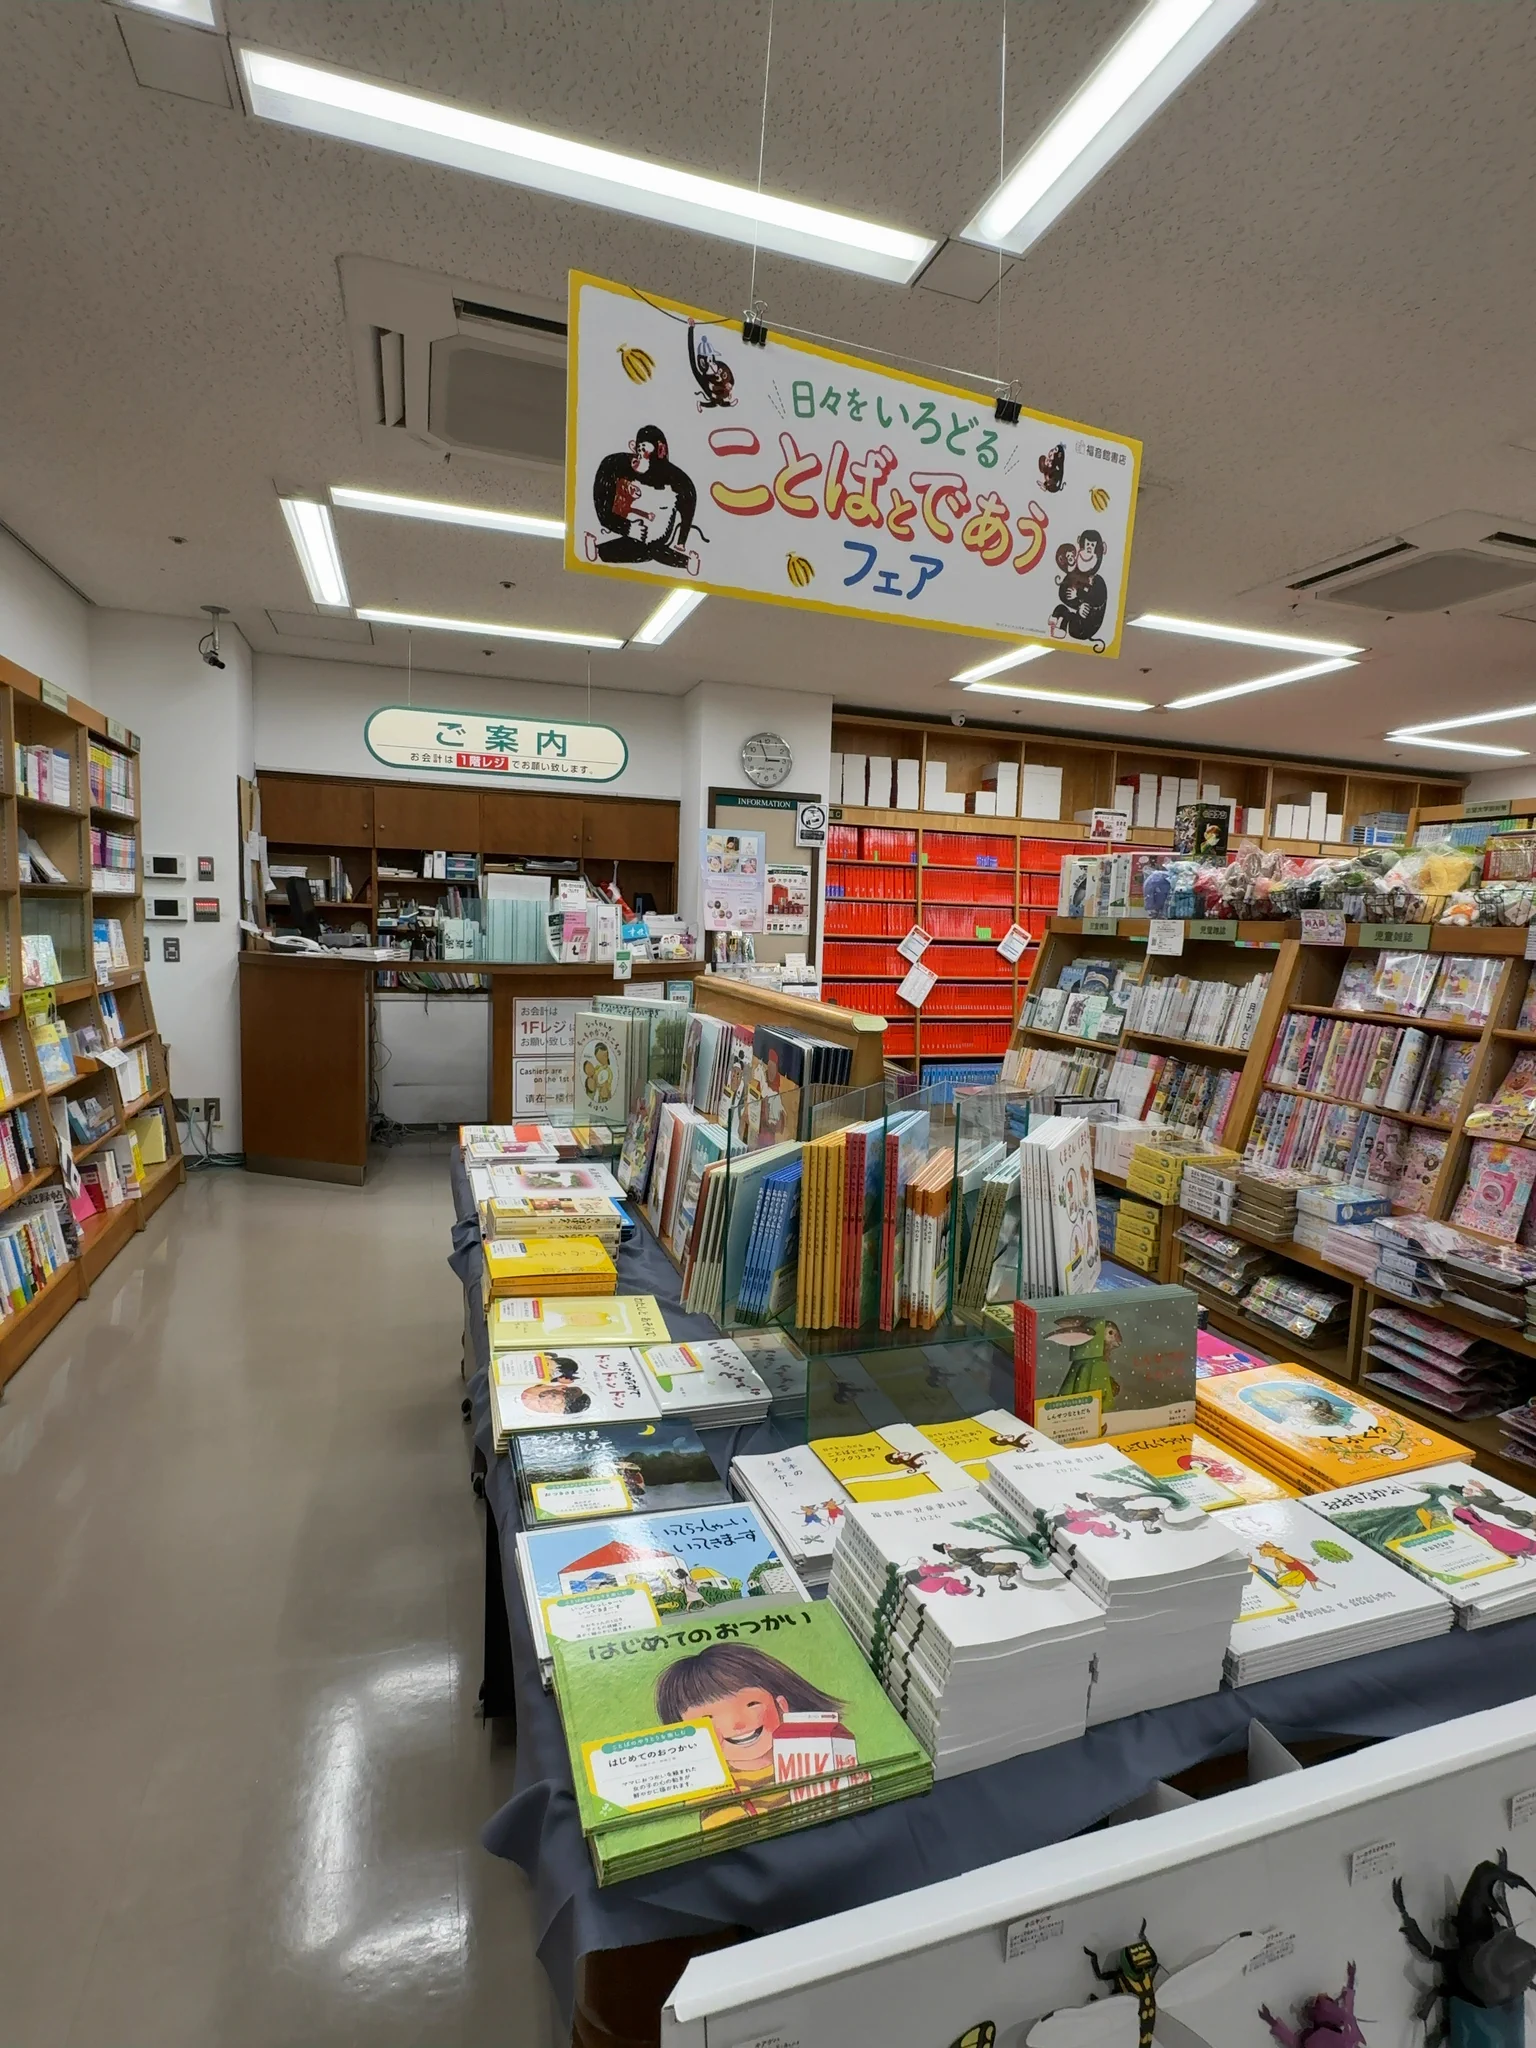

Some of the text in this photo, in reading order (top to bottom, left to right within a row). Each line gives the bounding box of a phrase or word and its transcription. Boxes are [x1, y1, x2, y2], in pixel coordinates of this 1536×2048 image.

[792, 379, 1001, 469] 日々をいろどる
[1087, 445, 1127, 466] 福音館書店
[706, 426, 1051, 575] ことばとであう
[842, 540, 945, 600] フェア
[436, 721, 568, 757] ご案内
[738, 797, 791, 808] INFORMATION
[1374, 930, 1414, 943] 児童雑誌
[521, 1006, 558, 1016] お会計は
[617, 1361, 641, 1398] からだのなかで
[1046, 1408, 1091, 1420] しんせつなともだち
[933, 1430, 983, 1443] ことばとであう
[940, 1437, 980, 1448] ブックリスト
[1320, 1425, 1387, 1445] てぶくろ
[827, 1446, 881, 1458] ことばとであう
[832, 1454, 876, 1463] ブックリスト
[766, 1460, 794, 1488] 与えかた
[780, 1455, 804, 1477] 絵本の
[1323, 1485, 1405, 1511] おおきなかぶ
[871, 1500, 968, 1519] 福音館の児童書目録
[662, 1517, 749, 1537] いってらっしゃーい
[673, 1528, 757, 1553] いってきまーす
[588, 1612, 812, 1661] はじめてのおつかい
[608, 1743, 698, 1767] はじめてのおつかい
